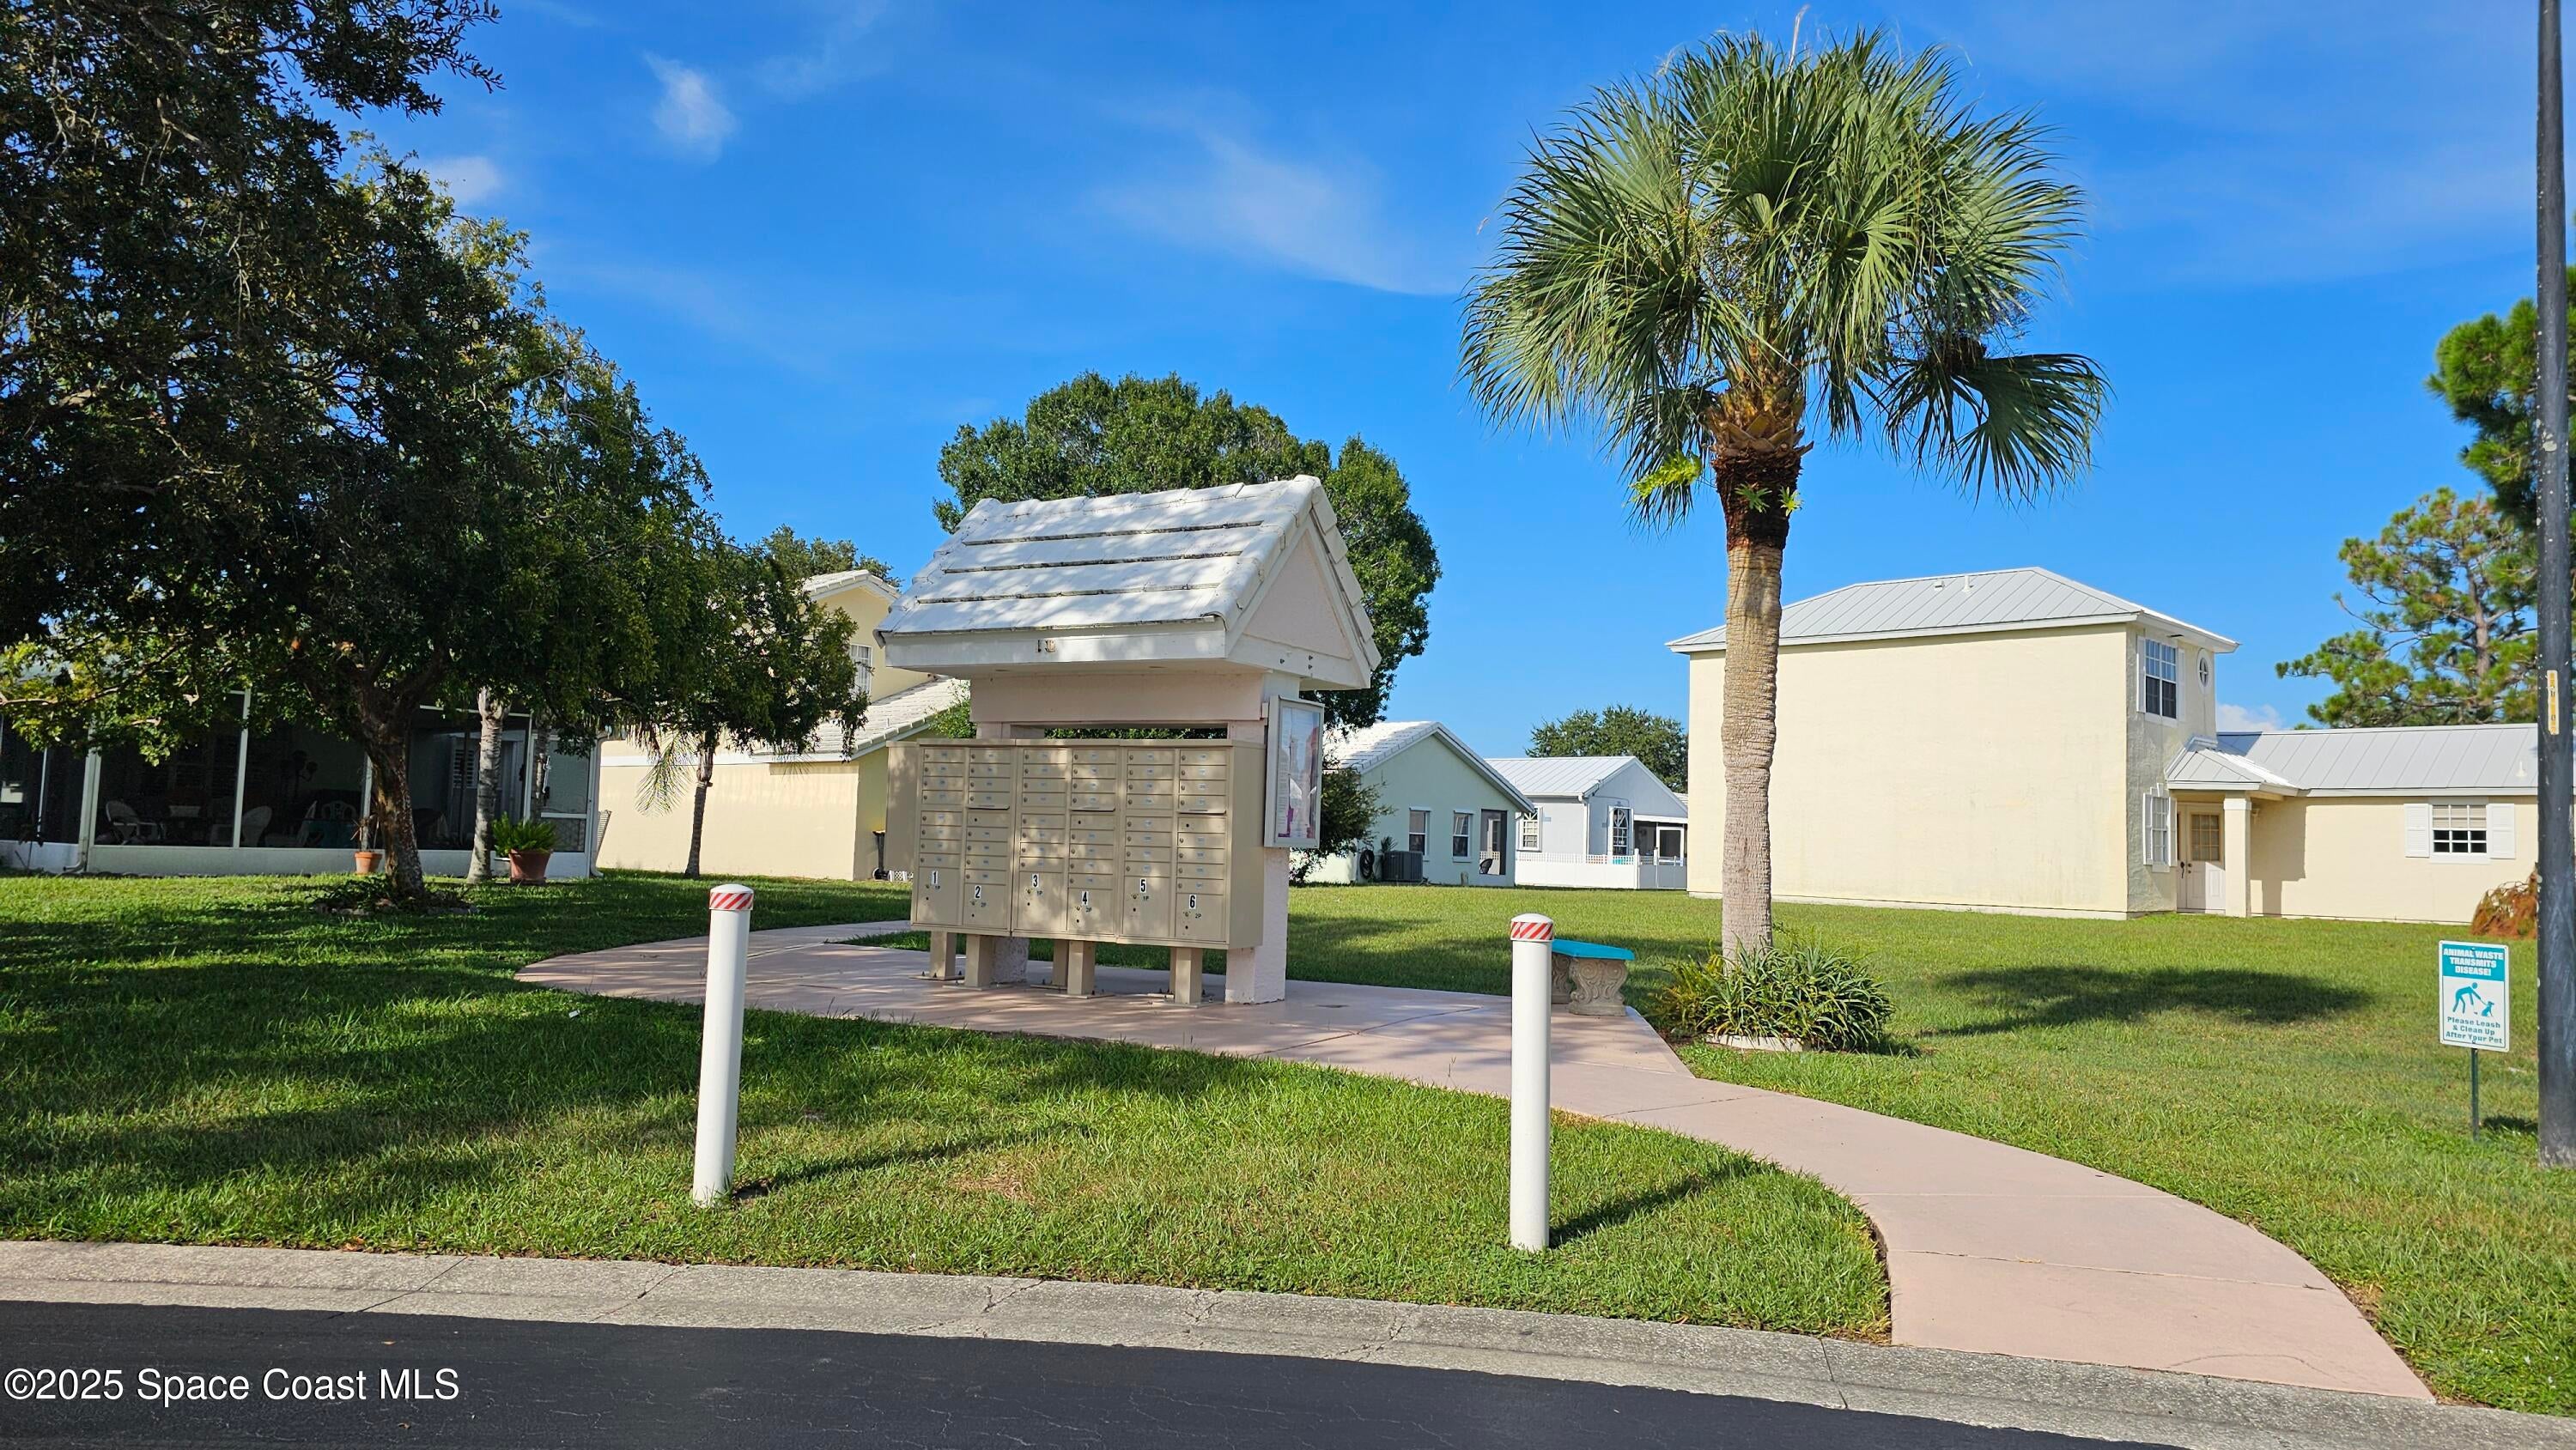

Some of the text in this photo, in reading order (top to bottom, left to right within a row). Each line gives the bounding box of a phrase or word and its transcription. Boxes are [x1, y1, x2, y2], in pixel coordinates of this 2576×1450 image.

[1033, 875, 1038, 888] 3
[1140, 879, 1146, 892] 5
[975, 885, 981, 899] 2
[1082, 891, 1088, 905] 4
[1189, 895, 1196, 908] 6
[2443, 948, 2504, 960] ANIMAL WASTE
[2449, 956, 2497, 968] TRANSMITS
[2455, 965, 2492, 976] DISEASE!
[2447, 1016, 2500, 1028] Please Leash
